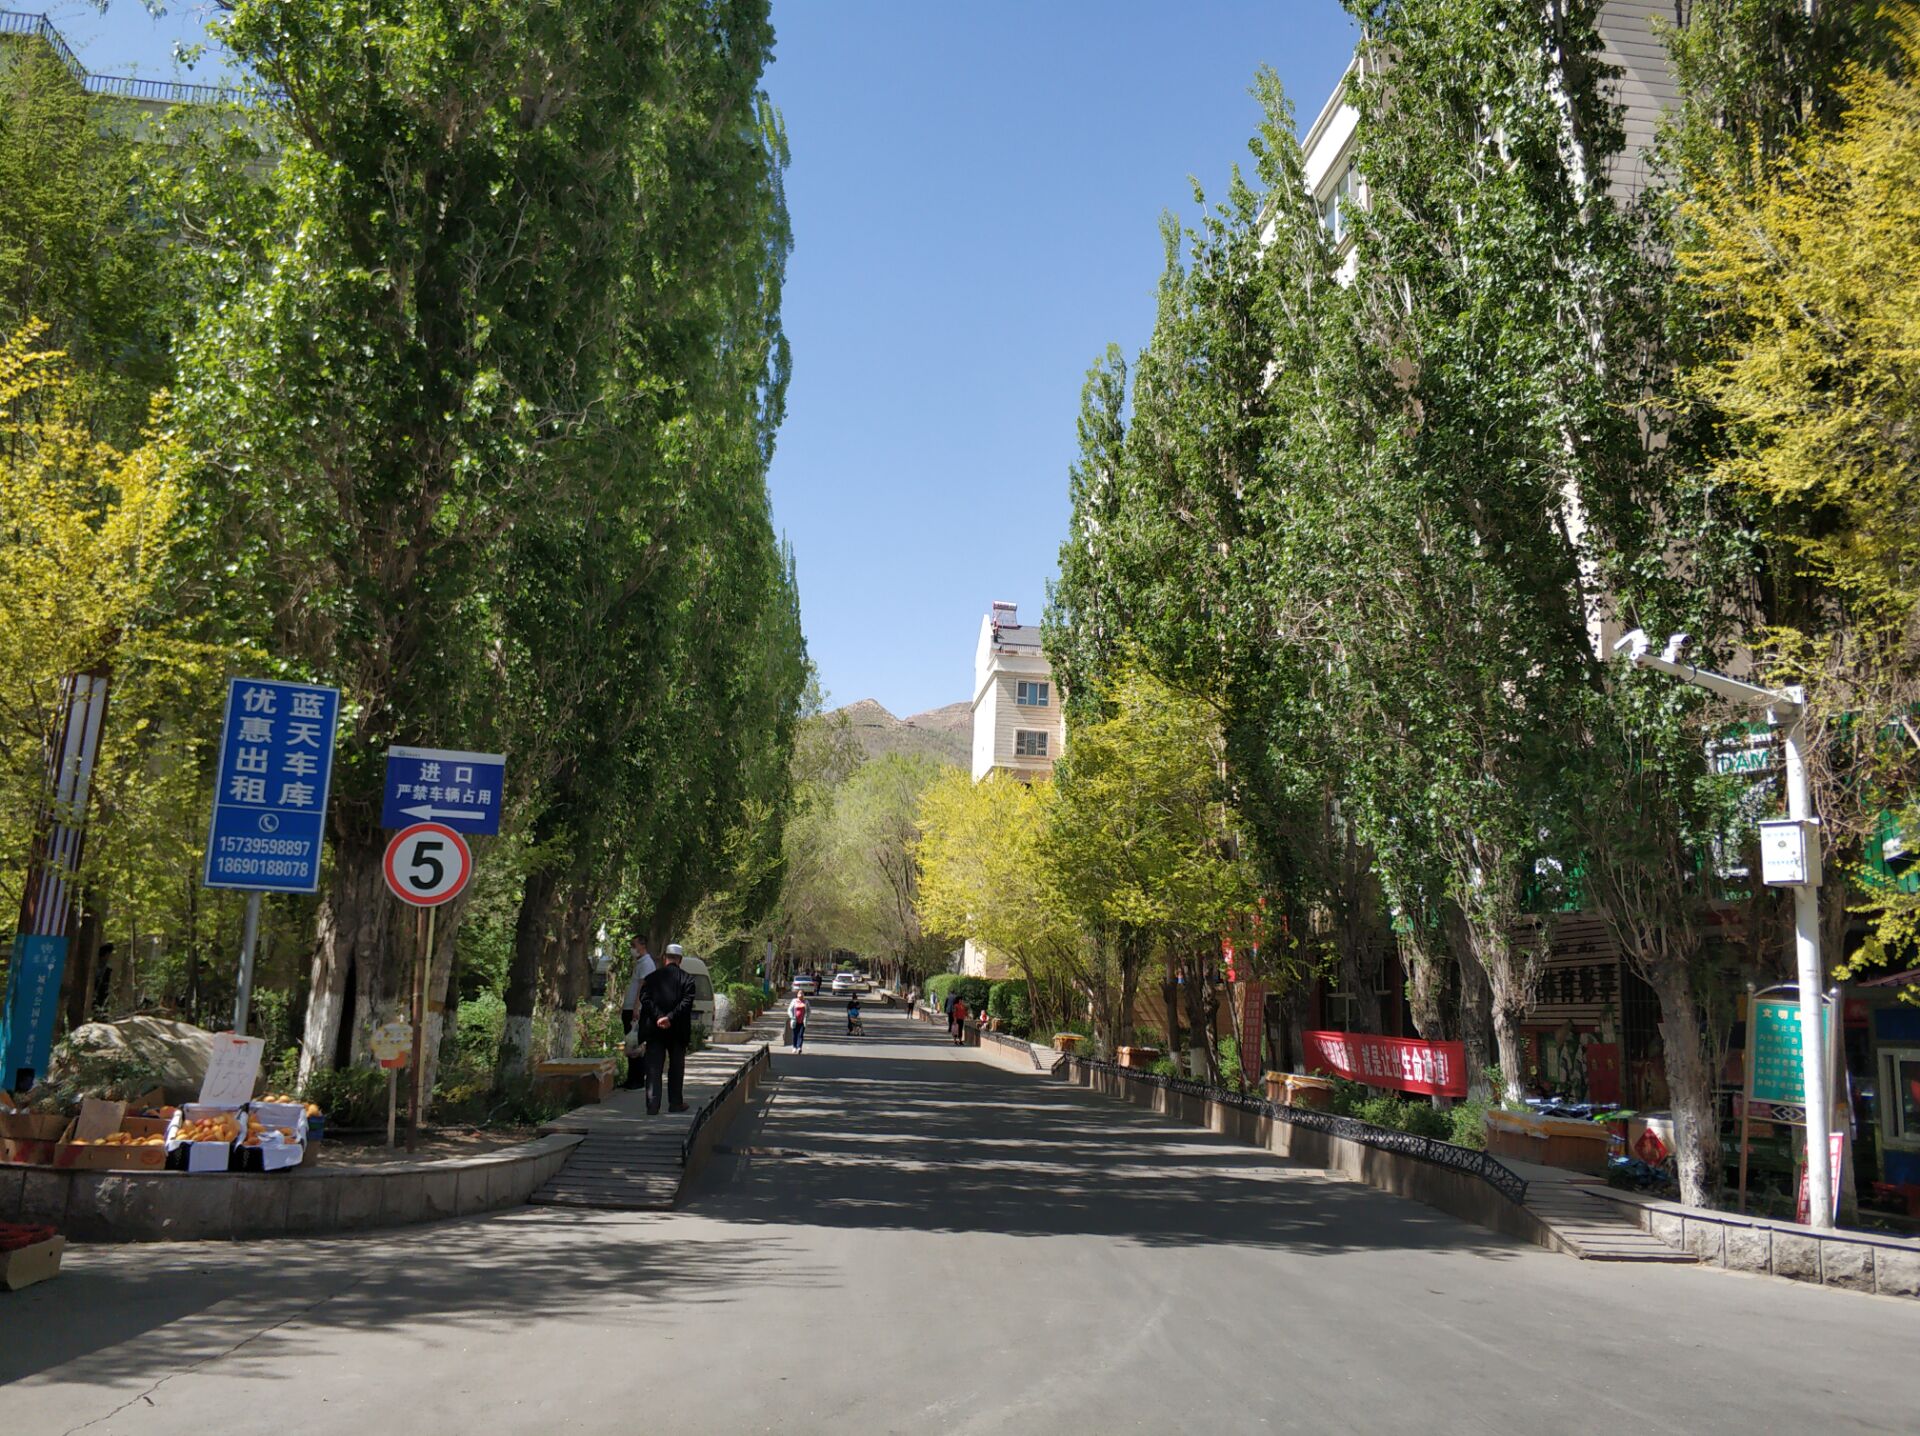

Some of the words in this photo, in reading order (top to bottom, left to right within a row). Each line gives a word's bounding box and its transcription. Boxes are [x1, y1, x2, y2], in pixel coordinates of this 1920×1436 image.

[230, 686, 277, 804] 优惠出租
[278, 692, 325, 807] 蓝天车库
[419, 762, 473, 784] 进口
[396, 784, 492, 805] 严禁车辆占用
[219, 836, 311, 857] 15739598897
[217, 857, 309, 878] 18690188078
[408, 841, 445, 890] 5
